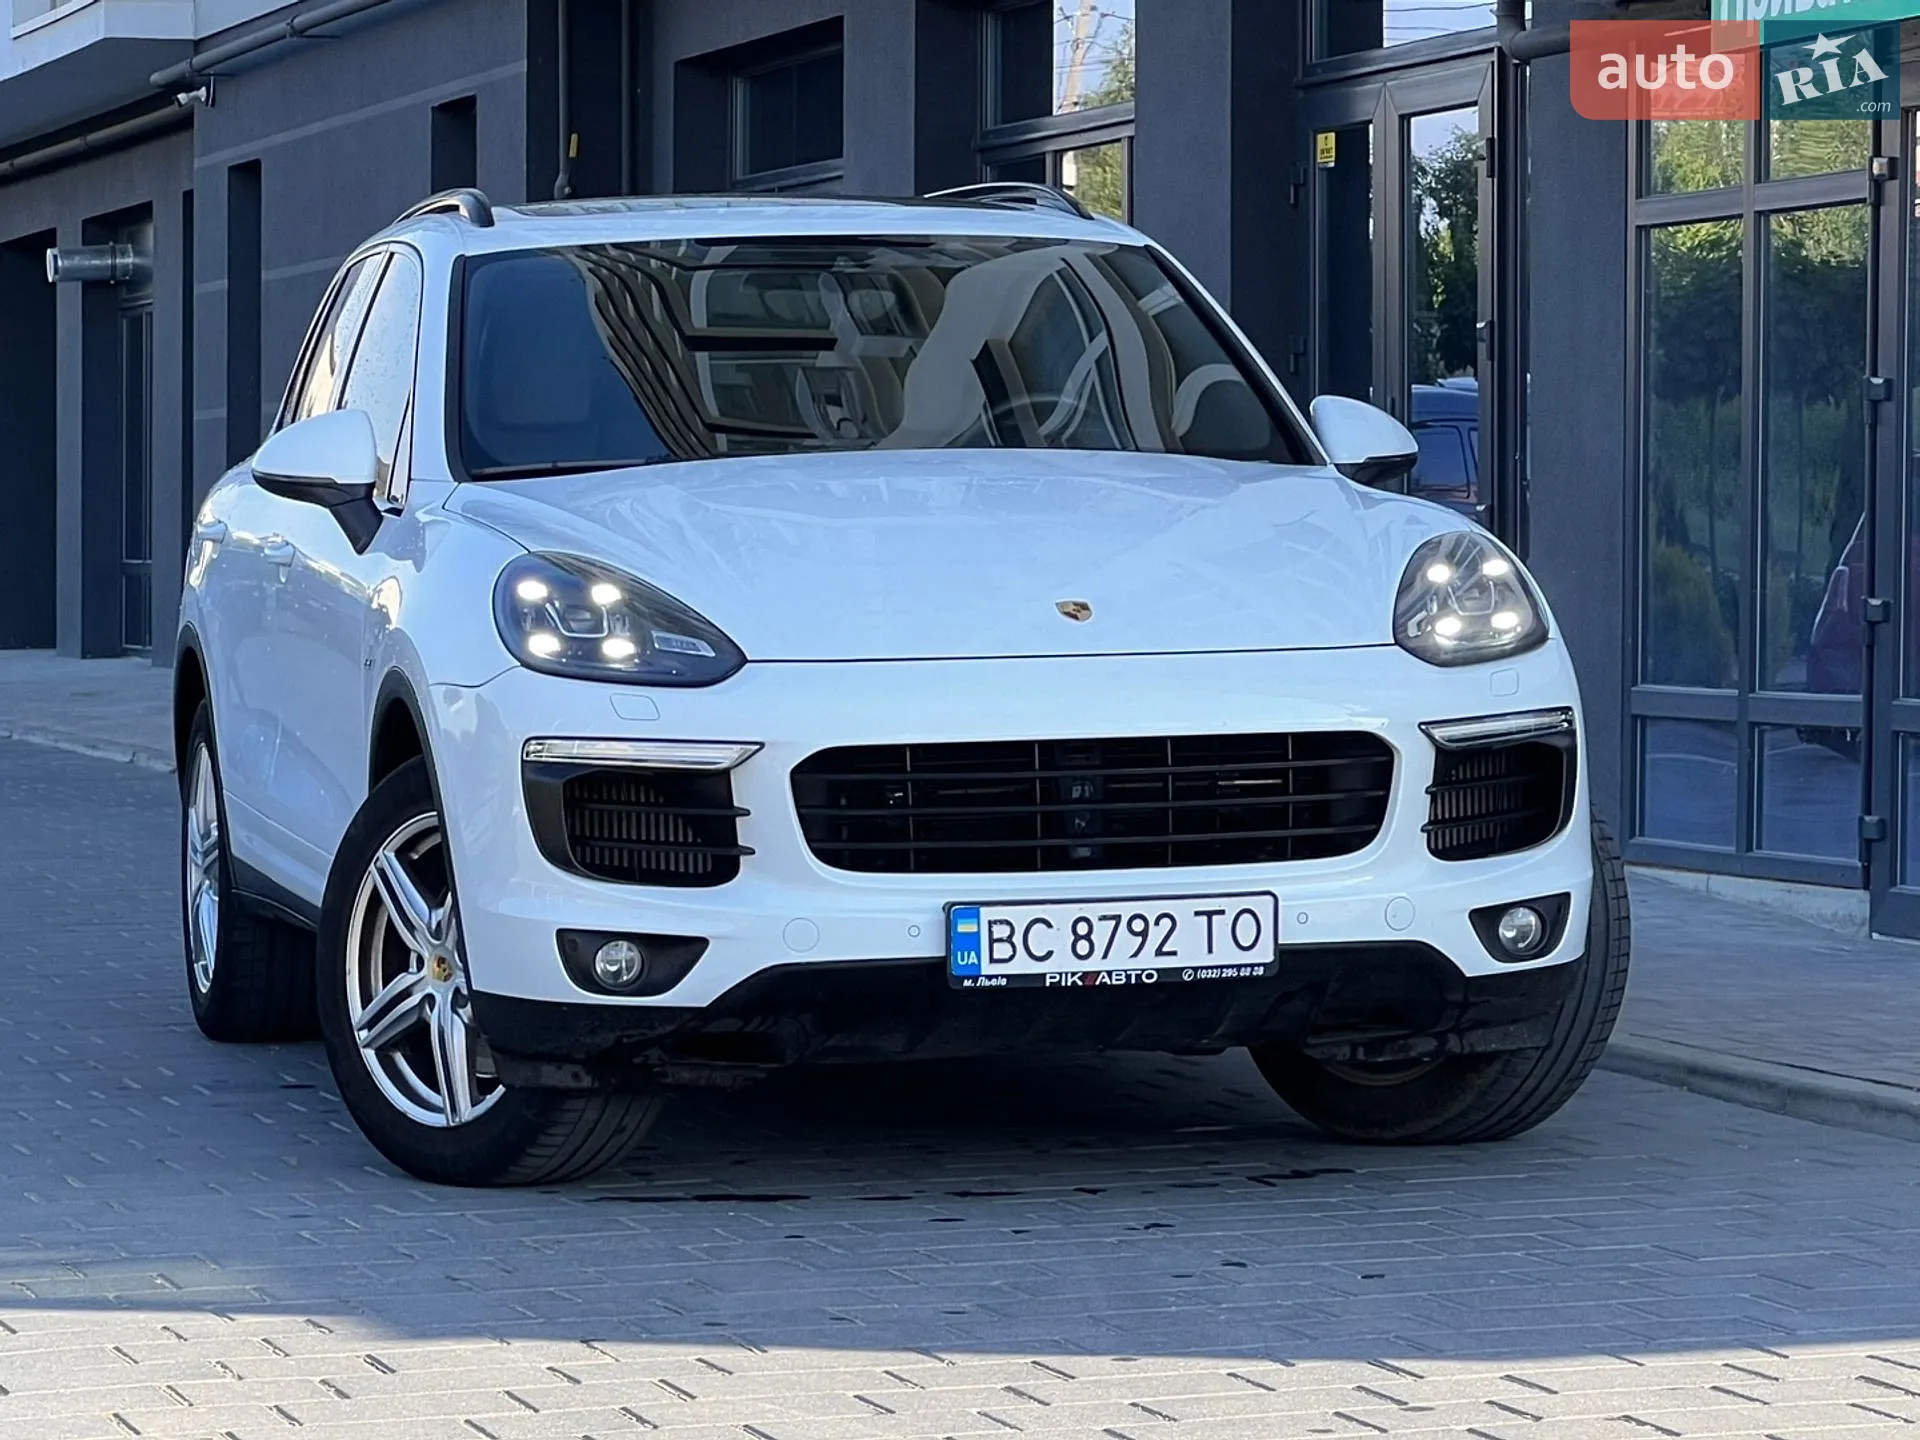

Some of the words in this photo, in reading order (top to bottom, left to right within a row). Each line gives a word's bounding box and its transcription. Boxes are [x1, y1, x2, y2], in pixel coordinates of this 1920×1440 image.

[987, 917, 1055, 964] BC
[1070, 912, 1179, 961] 8792
[1193, 907, 1262, 956] TO
[957, 951, 978, 965] UA
